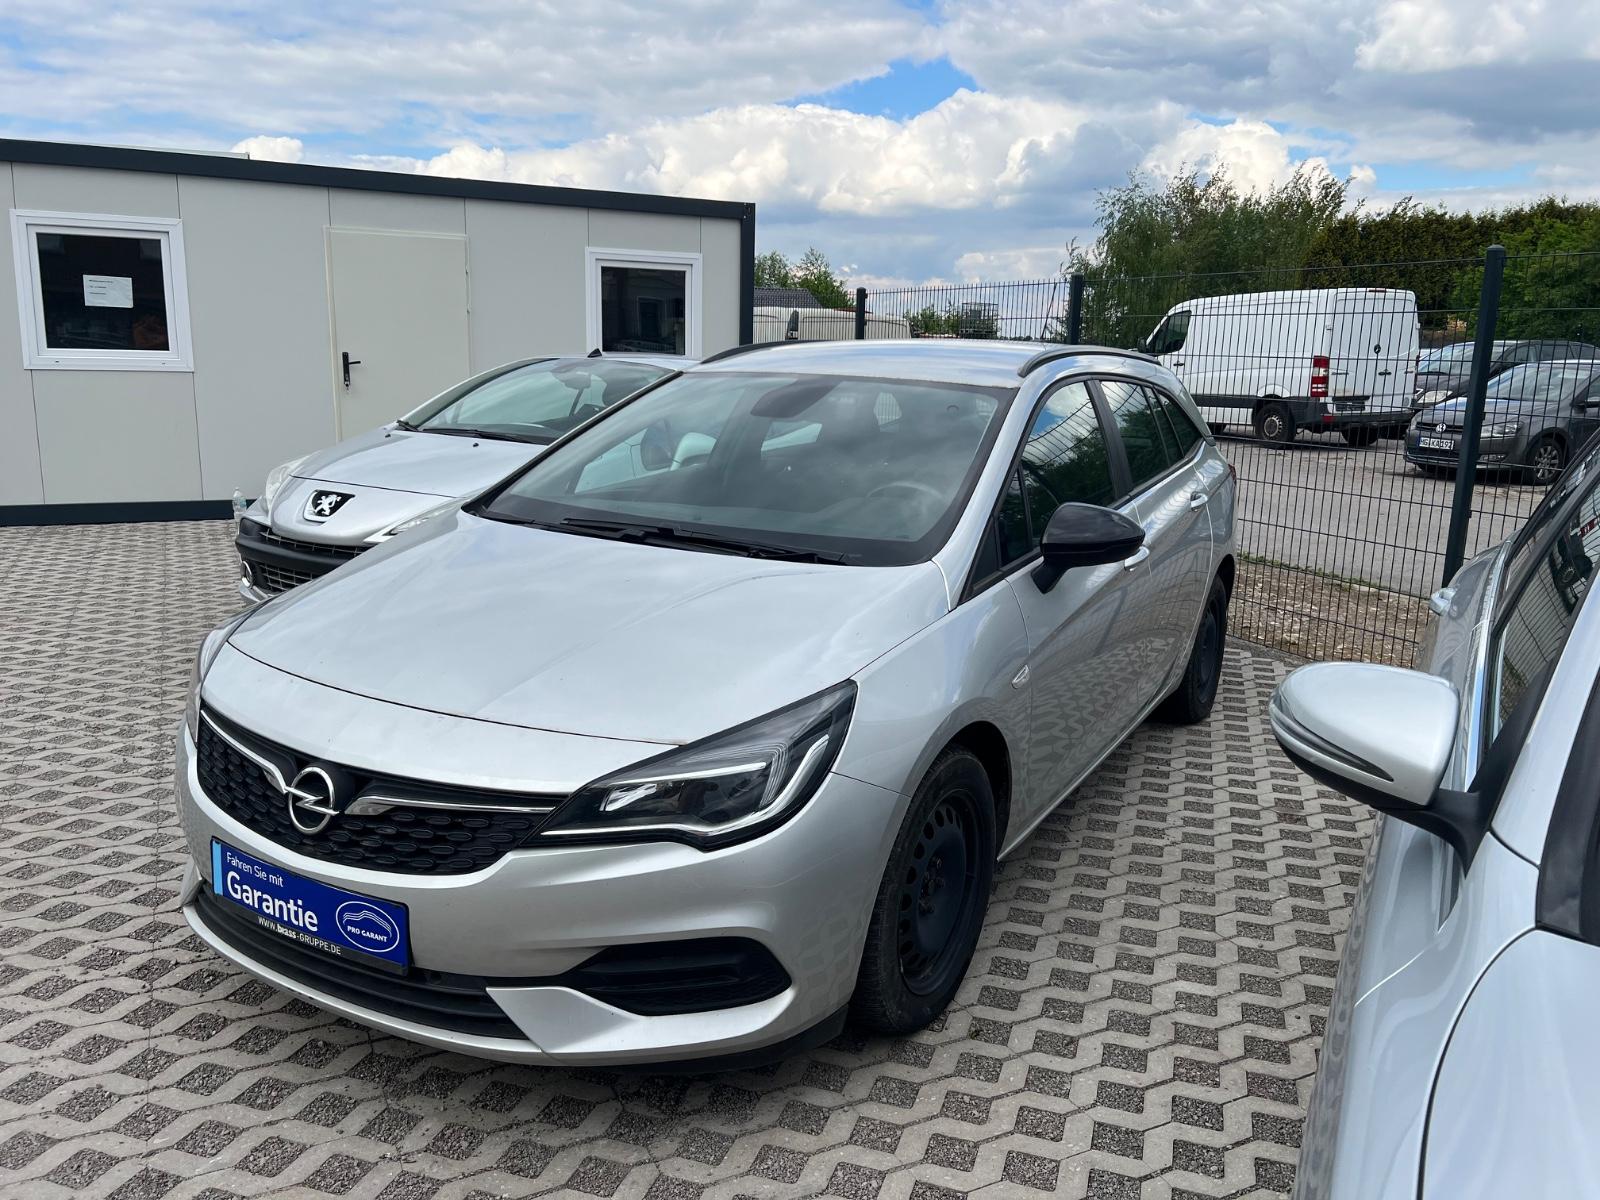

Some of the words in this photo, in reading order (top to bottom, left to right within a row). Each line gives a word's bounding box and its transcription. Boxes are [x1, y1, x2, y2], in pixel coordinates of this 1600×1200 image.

[226, 851, 253, 875] Fahren
[254, 865, 267, 881] Sie
[269, 873, 284, 888] mit
[226, 870, 319, 932] Garantie
[347, 925, 360, 935] PRO
[361, 930, 388, 943] GARANT
